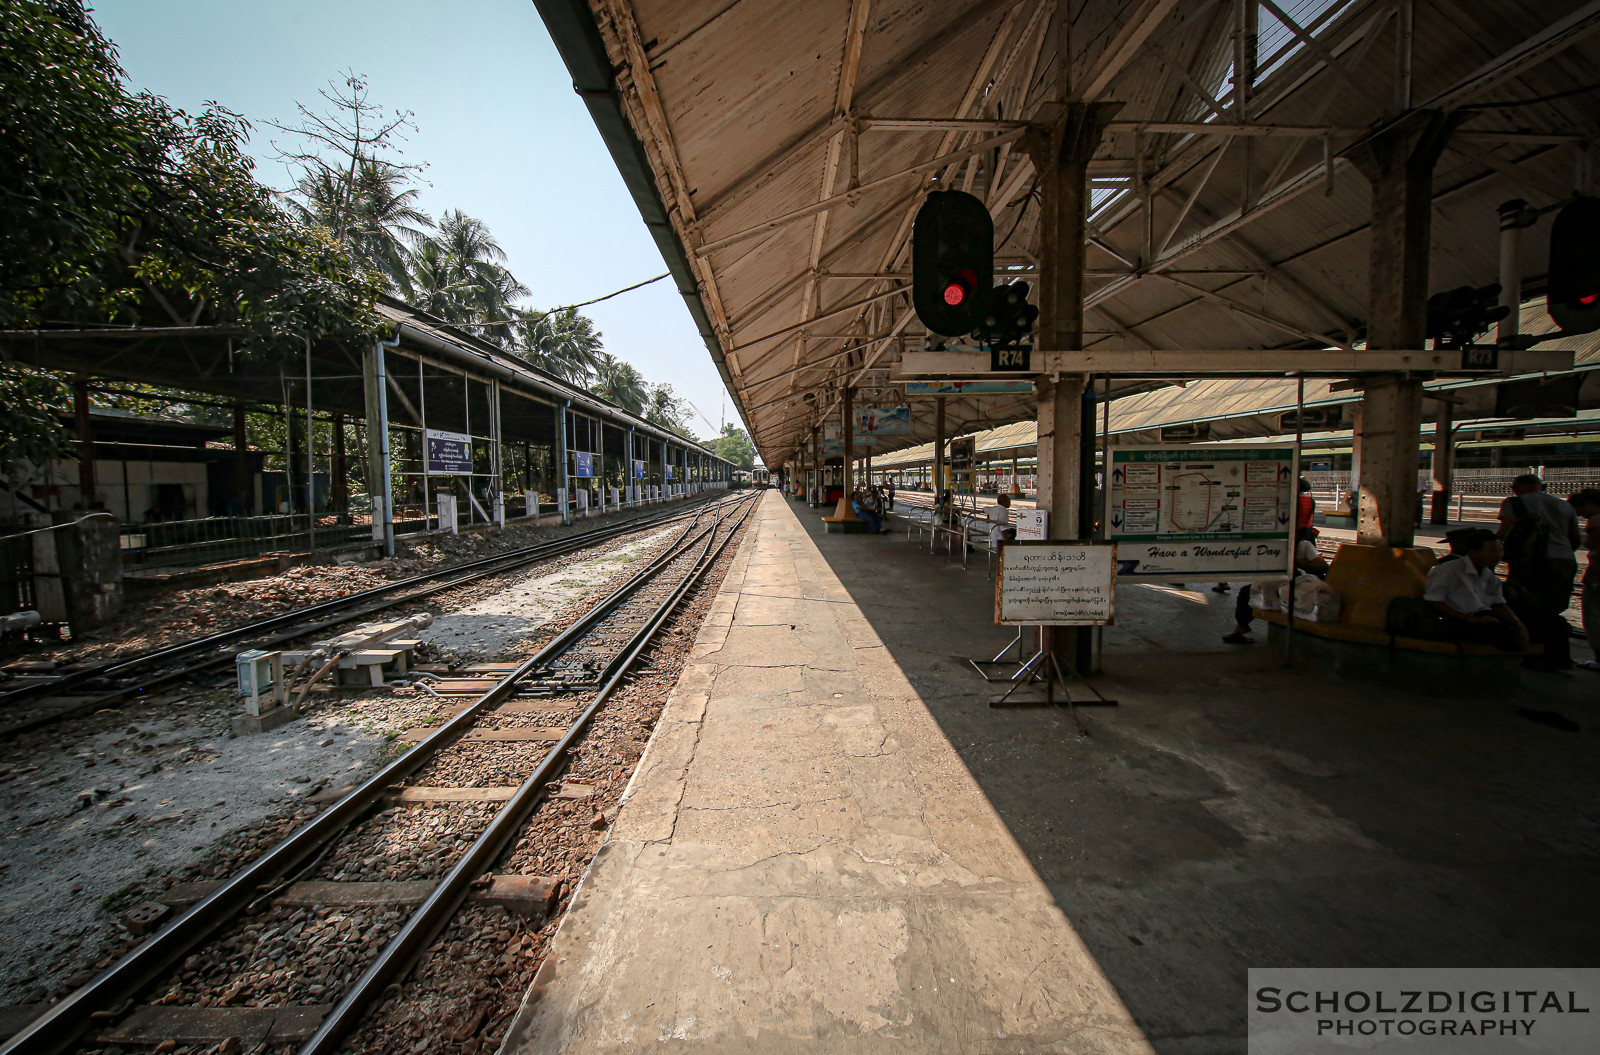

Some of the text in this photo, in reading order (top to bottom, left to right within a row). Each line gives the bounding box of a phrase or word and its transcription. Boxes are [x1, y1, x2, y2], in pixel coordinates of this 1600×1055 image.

[999, 350, 1023, 366] R74
[1469, 348, 1491, 363] R73
[1147, 547, 1177, 558] Have
[1193, 546, 1251, 559] Wonderful
[1256, 545, 1281, 558] Day
